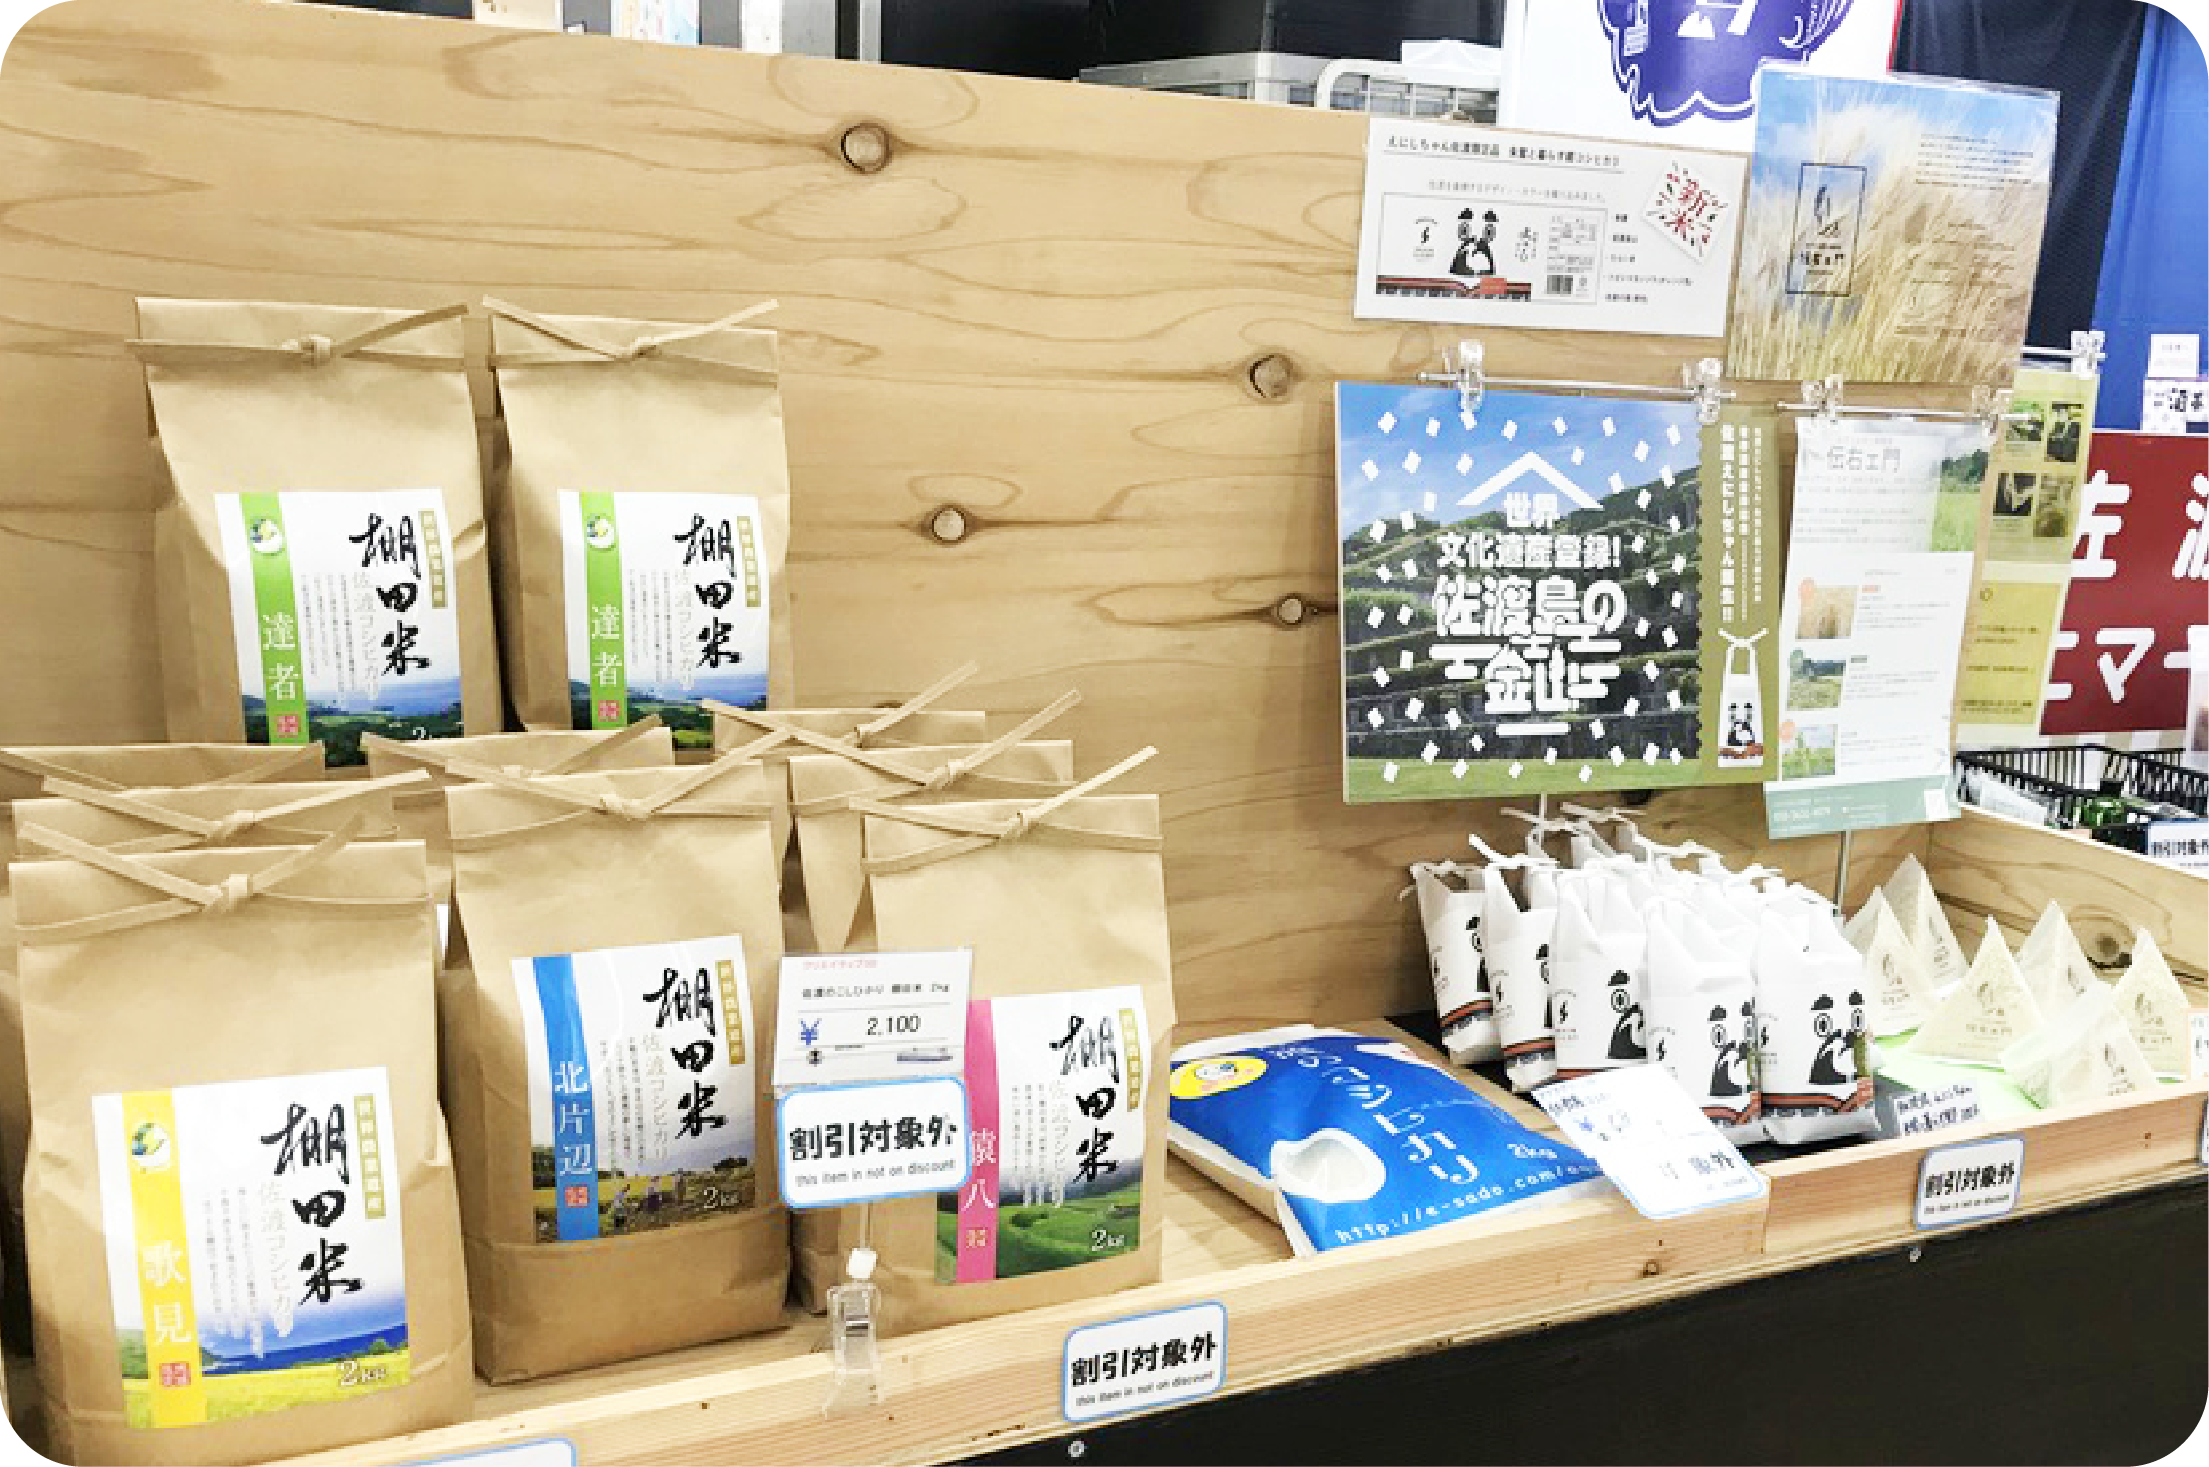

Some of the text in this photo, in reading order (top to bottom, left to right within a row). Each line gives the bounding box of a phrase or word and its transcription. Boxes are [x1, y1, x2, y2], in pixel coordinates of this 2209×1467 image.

[1503, 491, 1559, 529] 世界
[1436, 532, 1621, 568] 文化遺産登録!
[349, 513, 432, 676] 棚田米
[673, 514, 743, 669] 棚田米
[1431, 574, 1628, 638] 佐渡島の
[1484, 644, 1580, 714] 金山
[643, 967, 730, 1139] 棚田米
[1049, 1015, 1120, 1184] 棚田米
[789, 1115, 959, 1161] 割引対象外
[259, 1101, 364, 1306] 棚田米
[1071, 1330, 1219, 1387] 割引対象外
